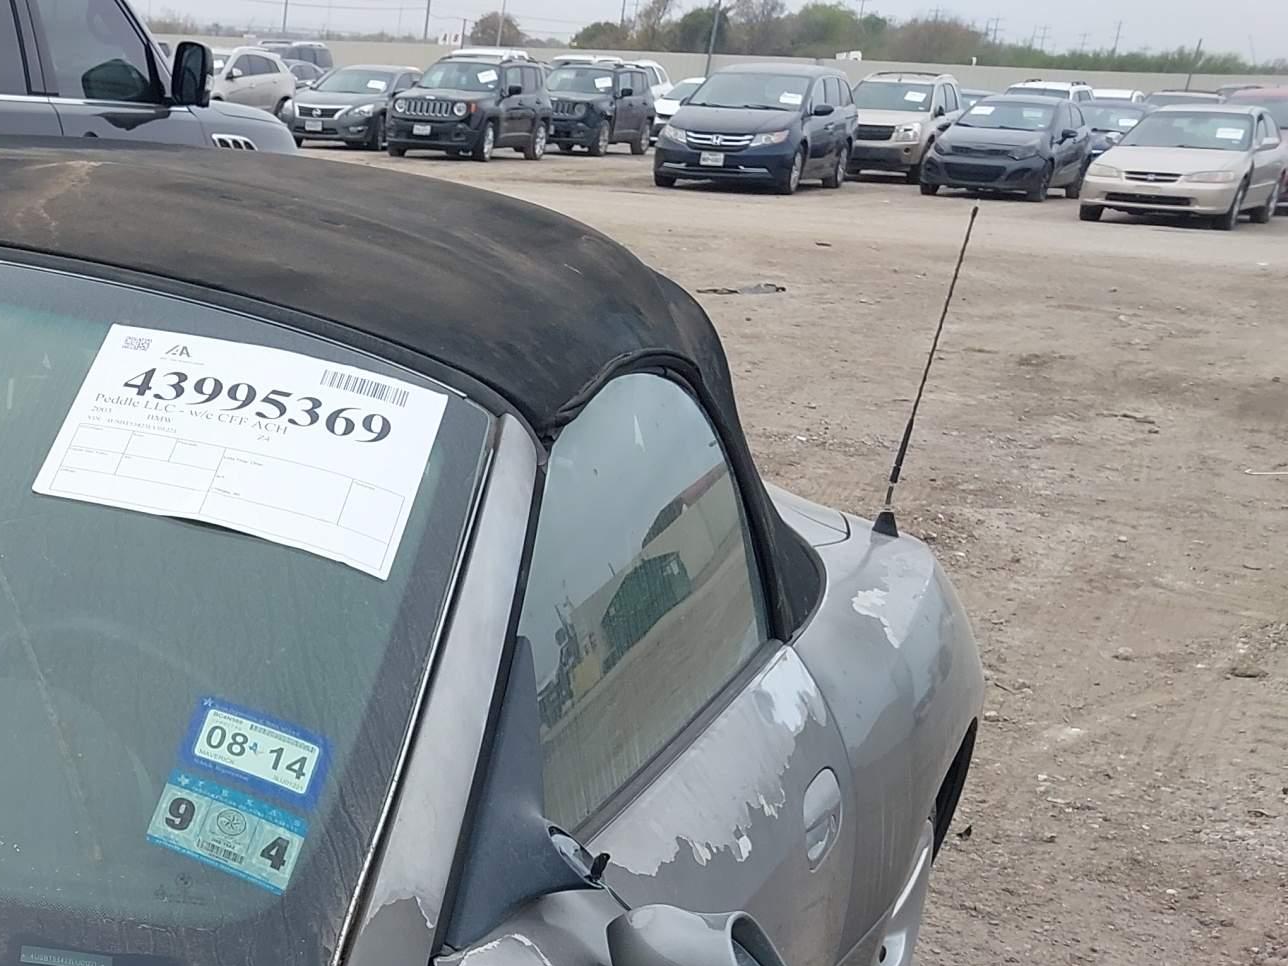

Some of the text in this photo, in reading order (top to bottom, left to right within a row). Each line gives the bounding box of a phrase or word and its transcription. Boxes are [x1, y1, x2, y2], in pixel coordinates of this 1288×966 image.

[95, 393, 140, 408] Peddle
[143, 401, 177, 414] LLC
[251, 420, 288, 435] ACH
[123, 367, 392, 443] 43995369
[205, 725, 249, 758] 08
[269, 747, 308, 780] 14
[165, 797, 196, 831] 9
[260, 836, 290, 871] 4
